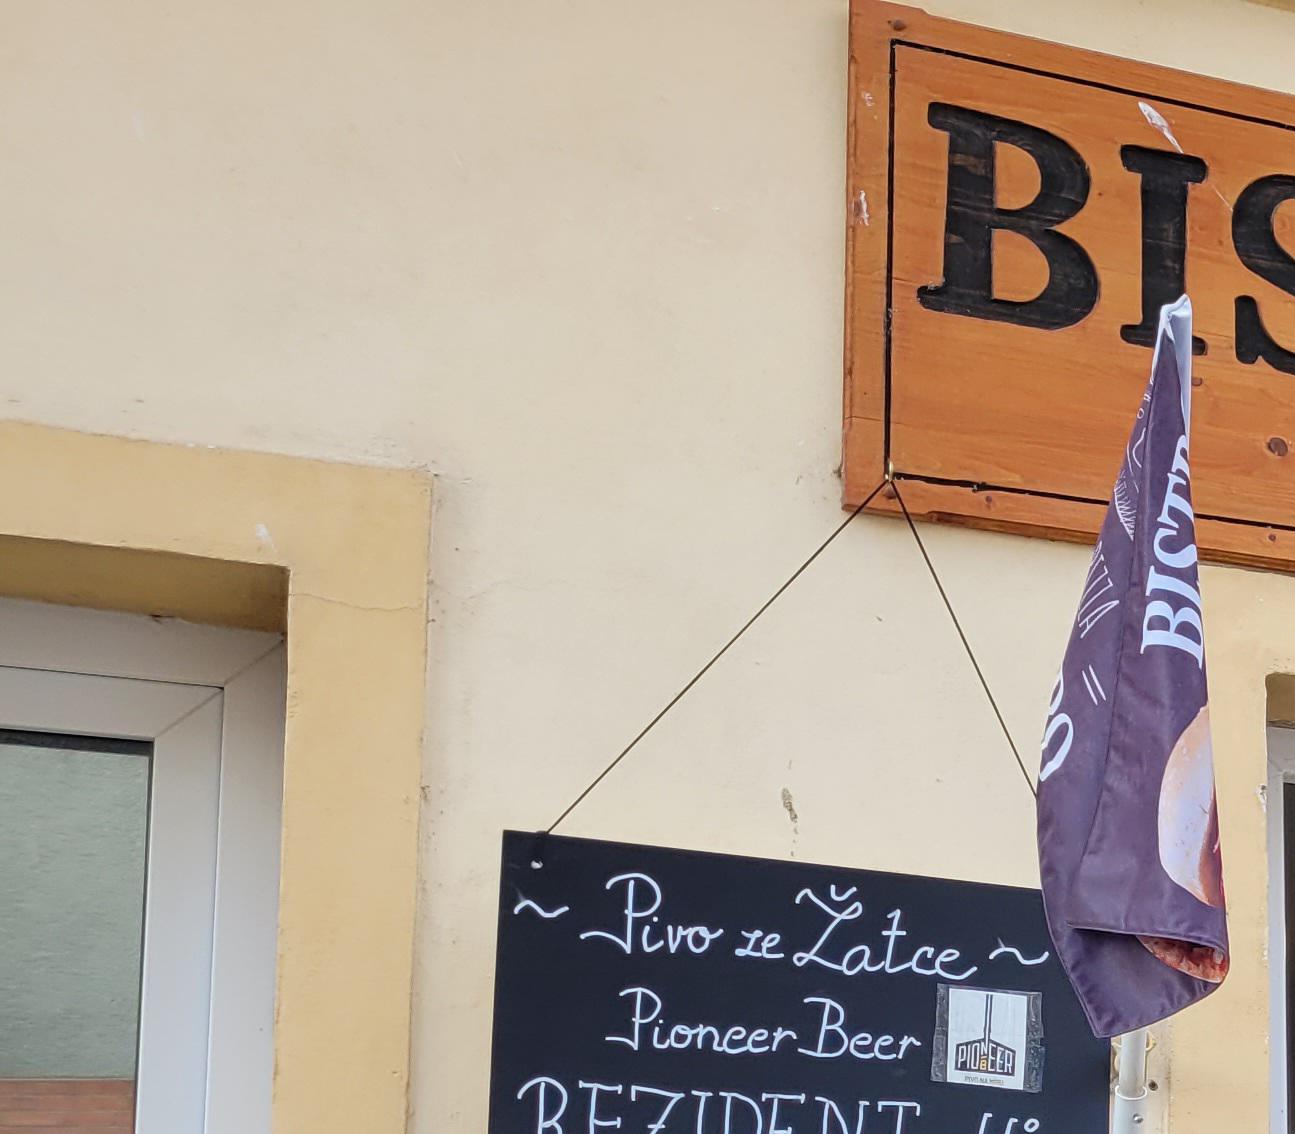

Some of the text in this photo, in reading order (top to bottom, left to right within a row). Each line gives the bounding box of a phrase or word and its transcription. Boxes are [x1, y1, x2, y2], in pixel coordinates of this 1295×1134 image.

[580, 872, 977, 980] Pivo ze Žatce
[605, 987, 921, 1060] Pioneer Beer
